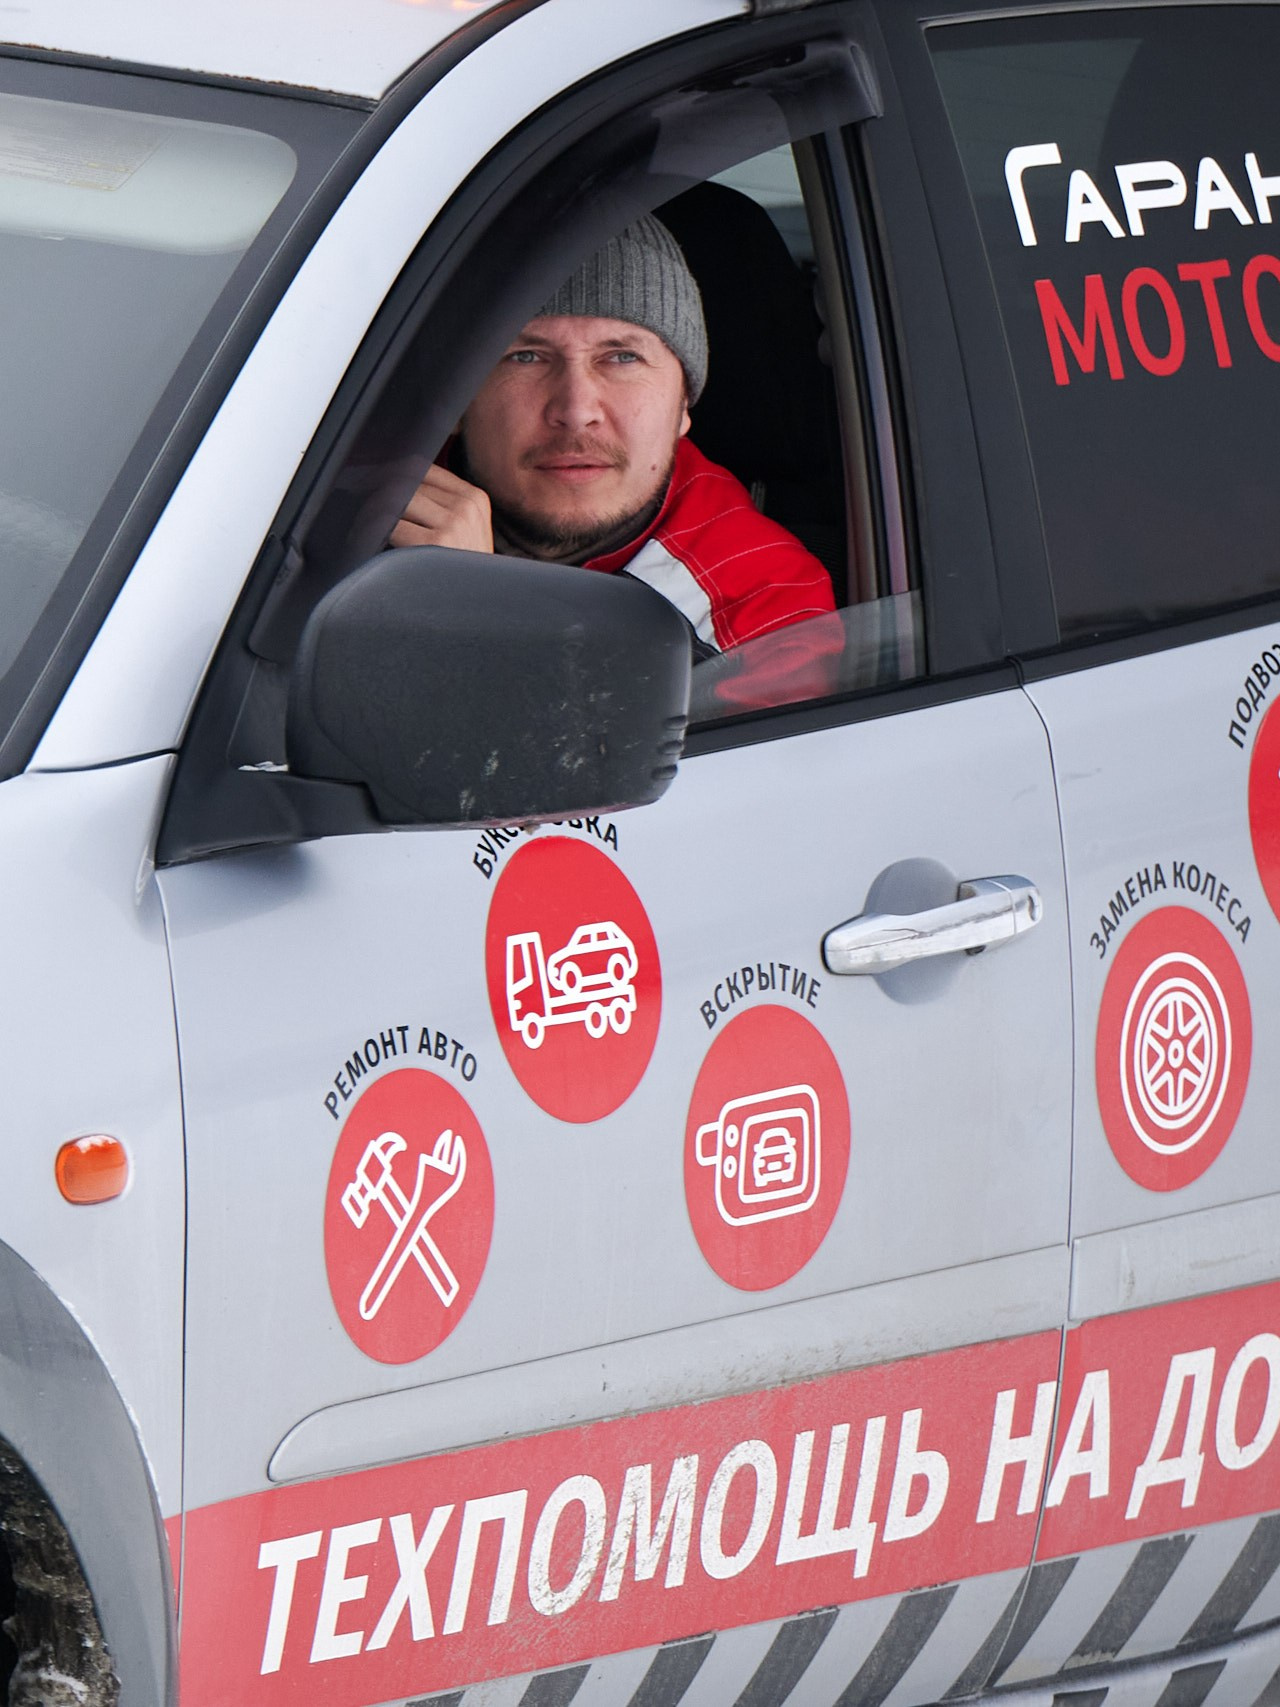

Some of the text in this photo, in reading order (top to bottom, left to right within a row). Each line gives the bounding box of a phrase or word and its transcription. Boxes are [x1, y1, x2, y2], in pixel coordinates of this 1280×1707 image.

[1089, 861, 1252, 960] ЗАМЕНА КОЛЕСА
[699, 962, 822, 1031] ВСКРЫТИЕ
[323, 1025, 478, 1120] РЕМОНТ АВТО
[257, 1407, 950, 1675] ТЕХПОМОЩЬ
[975, 1369, 1111, 1523] НА
